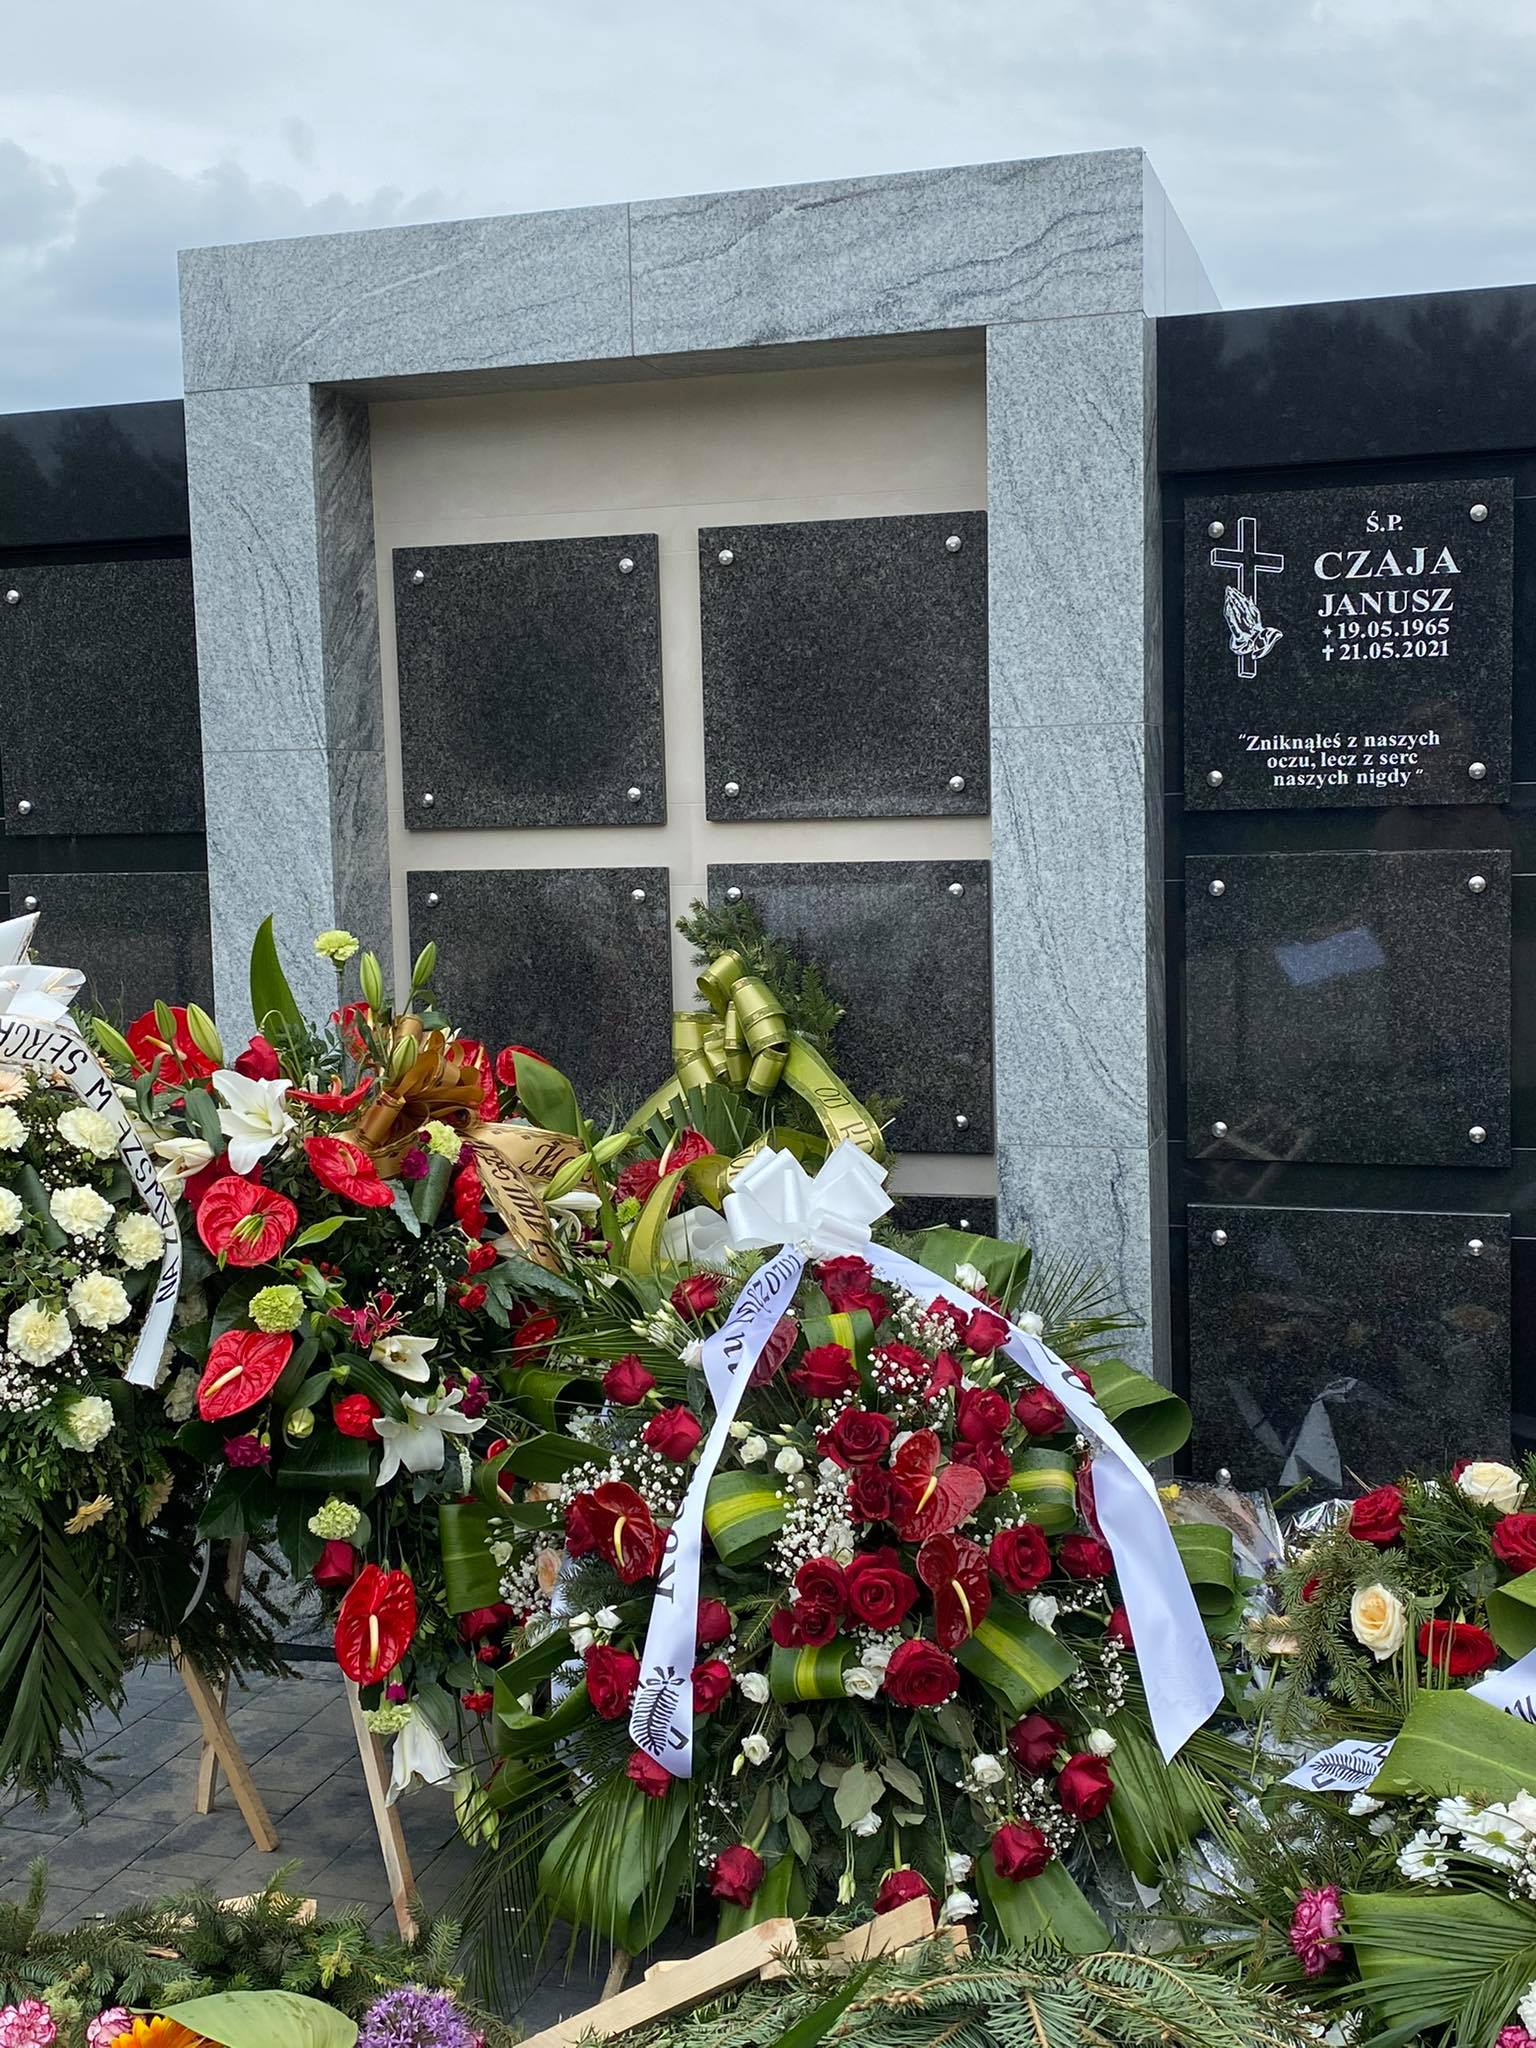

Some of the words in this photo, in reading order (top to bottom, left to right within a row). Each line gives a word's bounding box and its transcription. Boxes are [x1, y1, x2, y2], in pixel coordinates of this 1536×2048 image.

[1366, 511, 1404, 533] Ś.P.
[1313, 546, 1462, 581] CZAJA
[1317, 587, 1454, 618] JANUSZ
[1338, 617, 1450, 640] 19.05.1965
[1338, 638, 1450, 661] 21.05.2021
[1347, 736, 1358, 748] z
[1364, 730, 1440, 750] naszych
[1266, 755, 1317, 770] oczu,
[1320, 752, 1357, 767] lecz
[1363, 754, 1374, 766] z
[1379, 752, 1418, 766] serc
[1273, 770, 1349, 790] naszych
[85, 1076, 113, 1112] W
[815, 1087, 851, 1109] OD
[155, 1255, 179, 1304] NA
